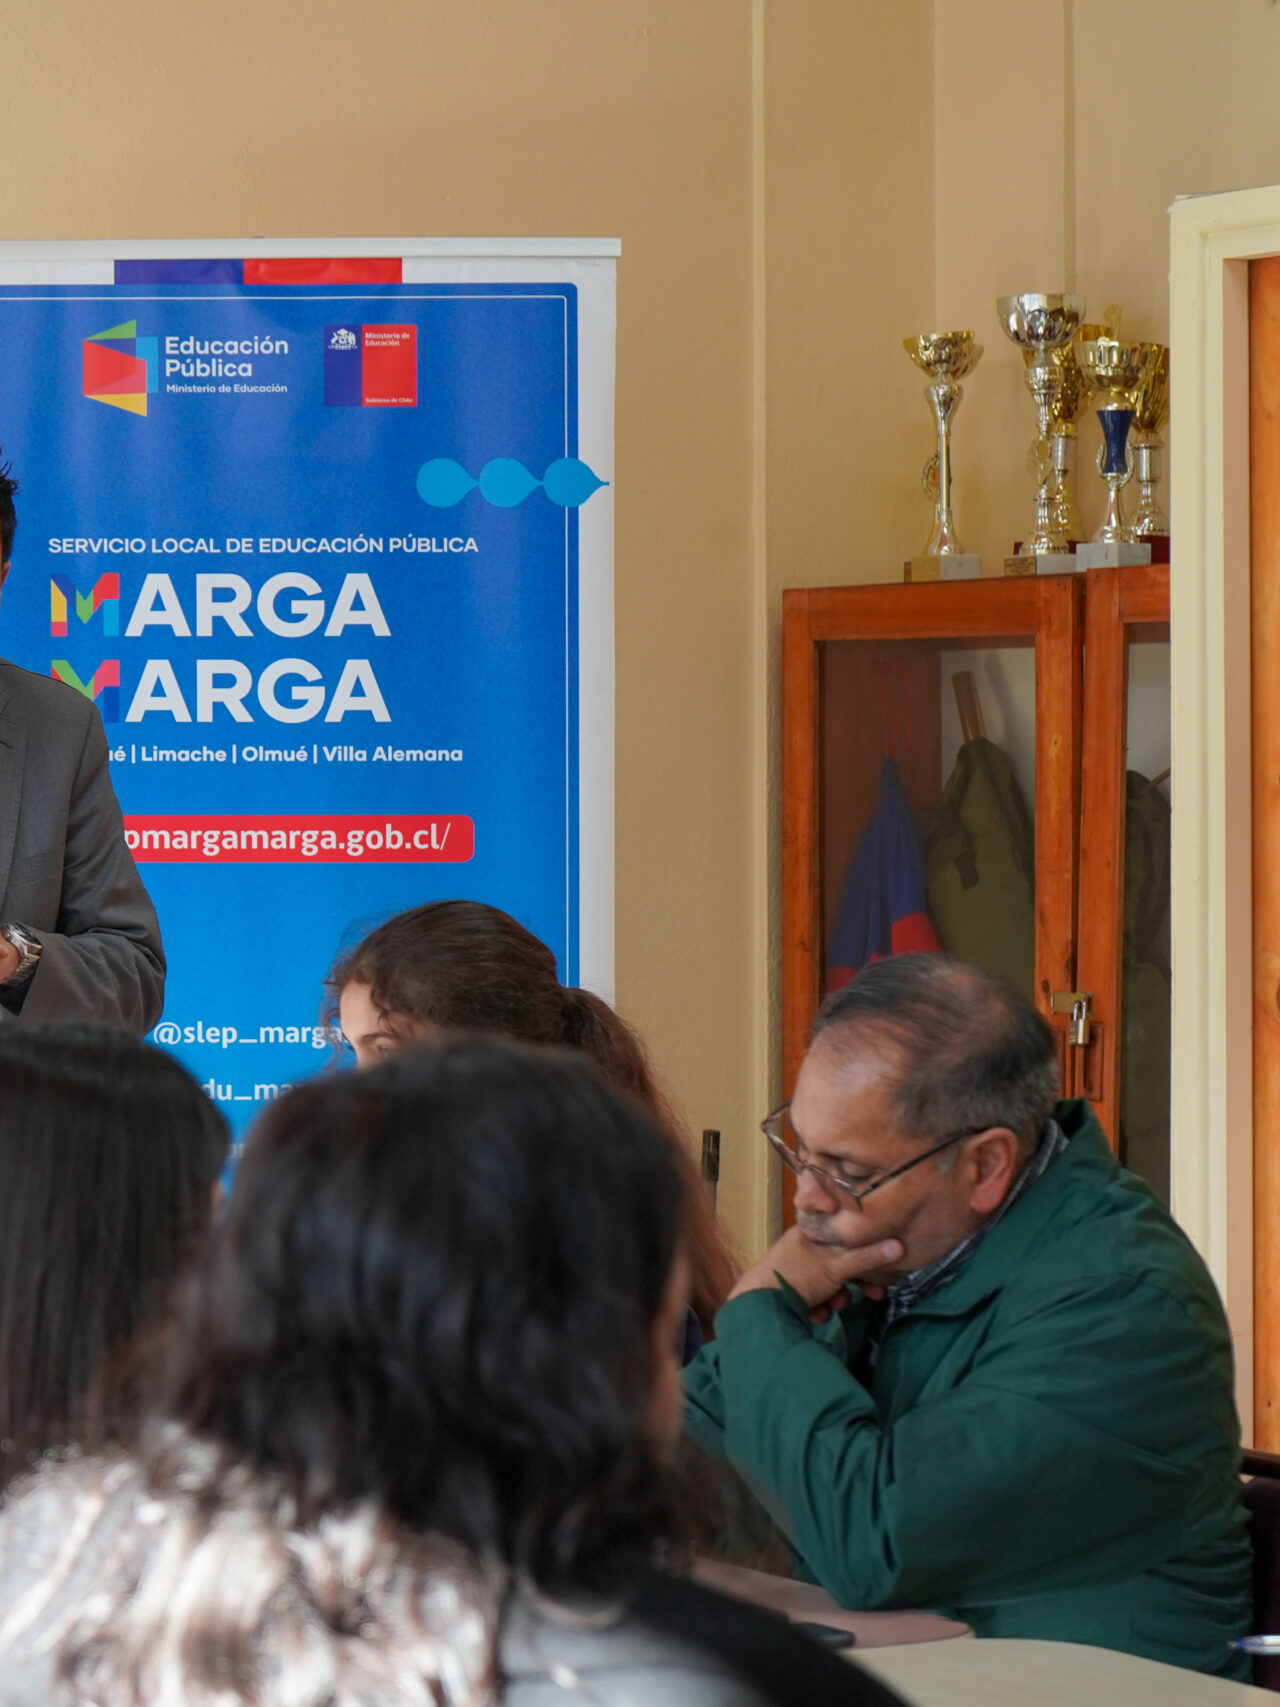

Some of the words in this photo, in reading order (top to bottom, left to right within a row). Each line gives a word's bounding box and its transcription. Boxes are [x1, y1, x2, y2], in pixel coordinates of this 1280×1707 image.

[165, 335, 289, 355] Educación
[364, 332, 400, 340] Ministerio
[364, 339, 401, 347] Educación
[165, 358, 253, 378] Pública
[166, 383, 216, 393] Ministerio
[217, 383, 232, 393] de
[233, 383, 288, 393] Educación
[48, 537, 147, 554] SERVICIO
[151, 537, 222, 554] LOCAL
[226, 537, 254, 554] DE
[259, 533, 384, 554] EDUCACIÓN
[389, 533, 480, 553] PÚBLICA
[50, 571, 392, 638] MARGA
[51, 657, 392, 724] MARGA
[141, 745, 228, 762] Limache
[241, 745, 309, 762] Olmué
[322, 745, 368, 762] Villa
[371, 745, 463, 762] Alemana
